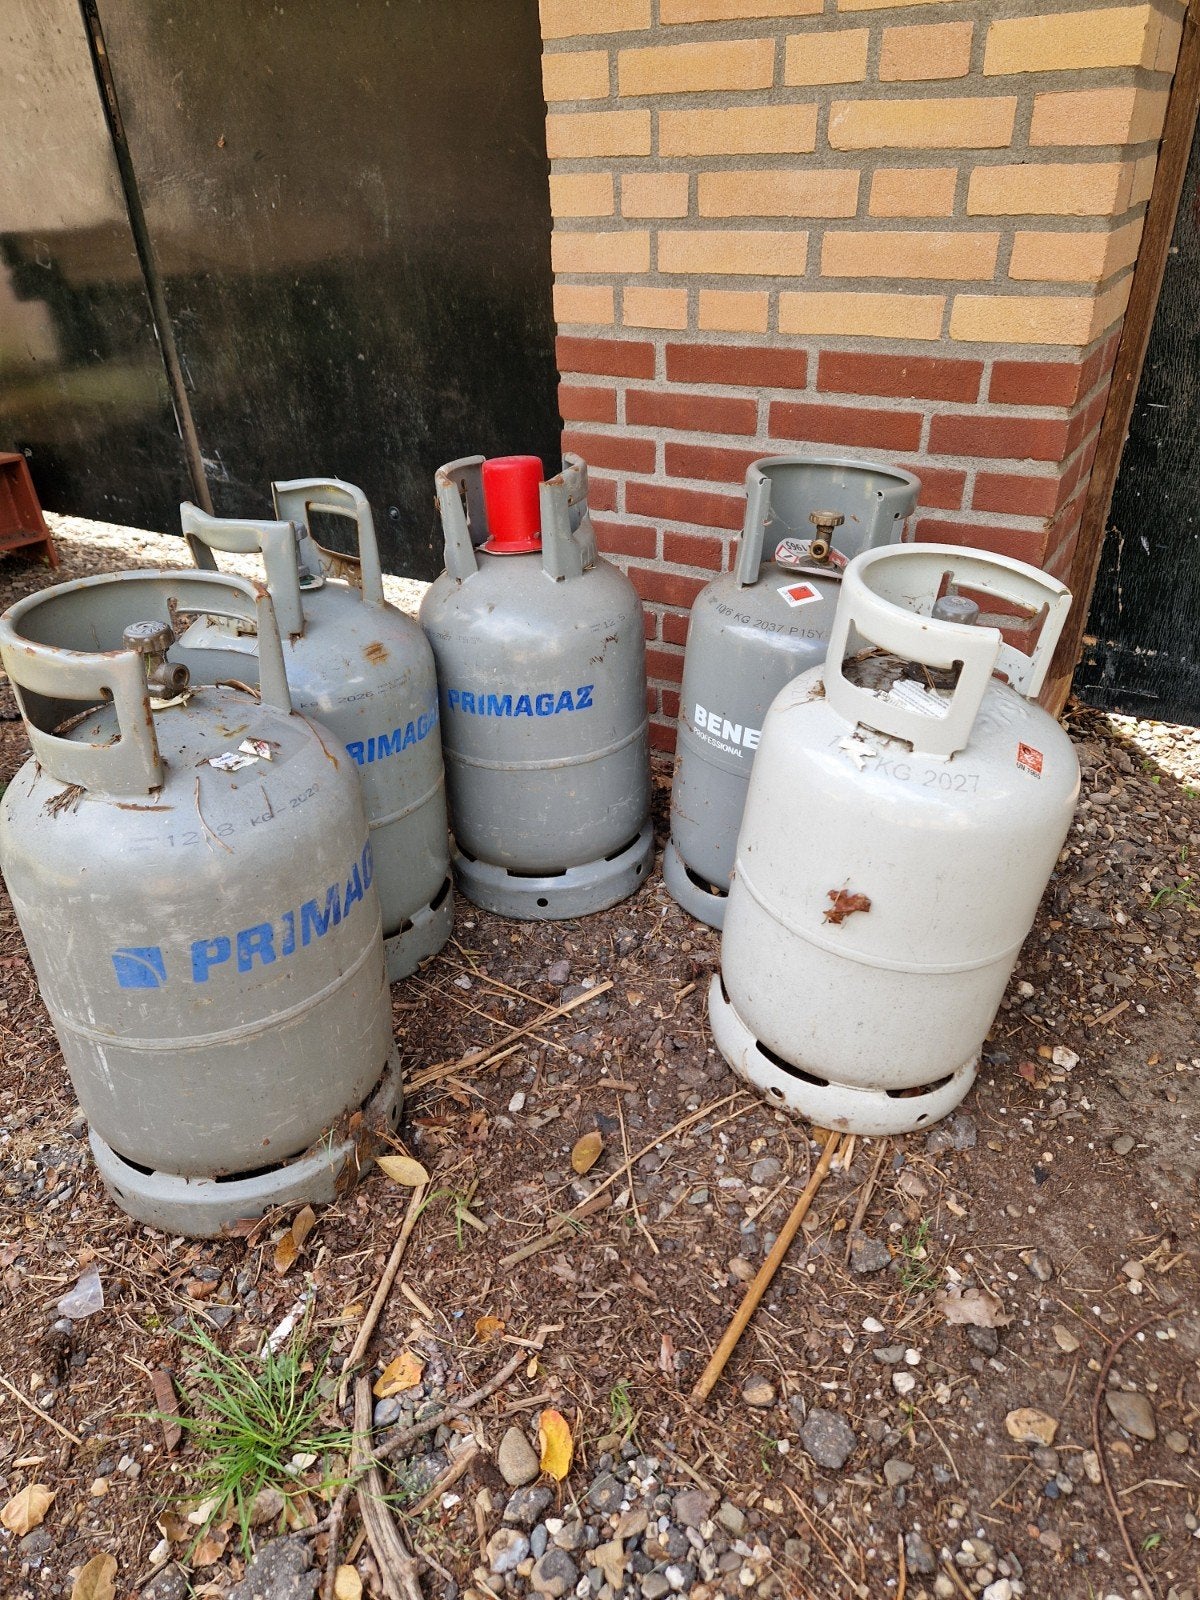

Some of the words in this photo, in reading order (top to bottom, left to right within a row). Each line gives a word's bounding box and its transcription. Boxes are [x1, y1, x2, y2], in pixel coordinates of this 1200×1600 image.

[733, 613, 751, 624] KG
[752, 619, 785, 633] 2037
[447, 685, 594, 717] PRIMAGAZ
[693, 726, 744, 758] PROFESSIONAL
[694, 703, 762, 750] BENE
[874, 758, 912, 781] KG
[922, 769, 980, 793] 2027
